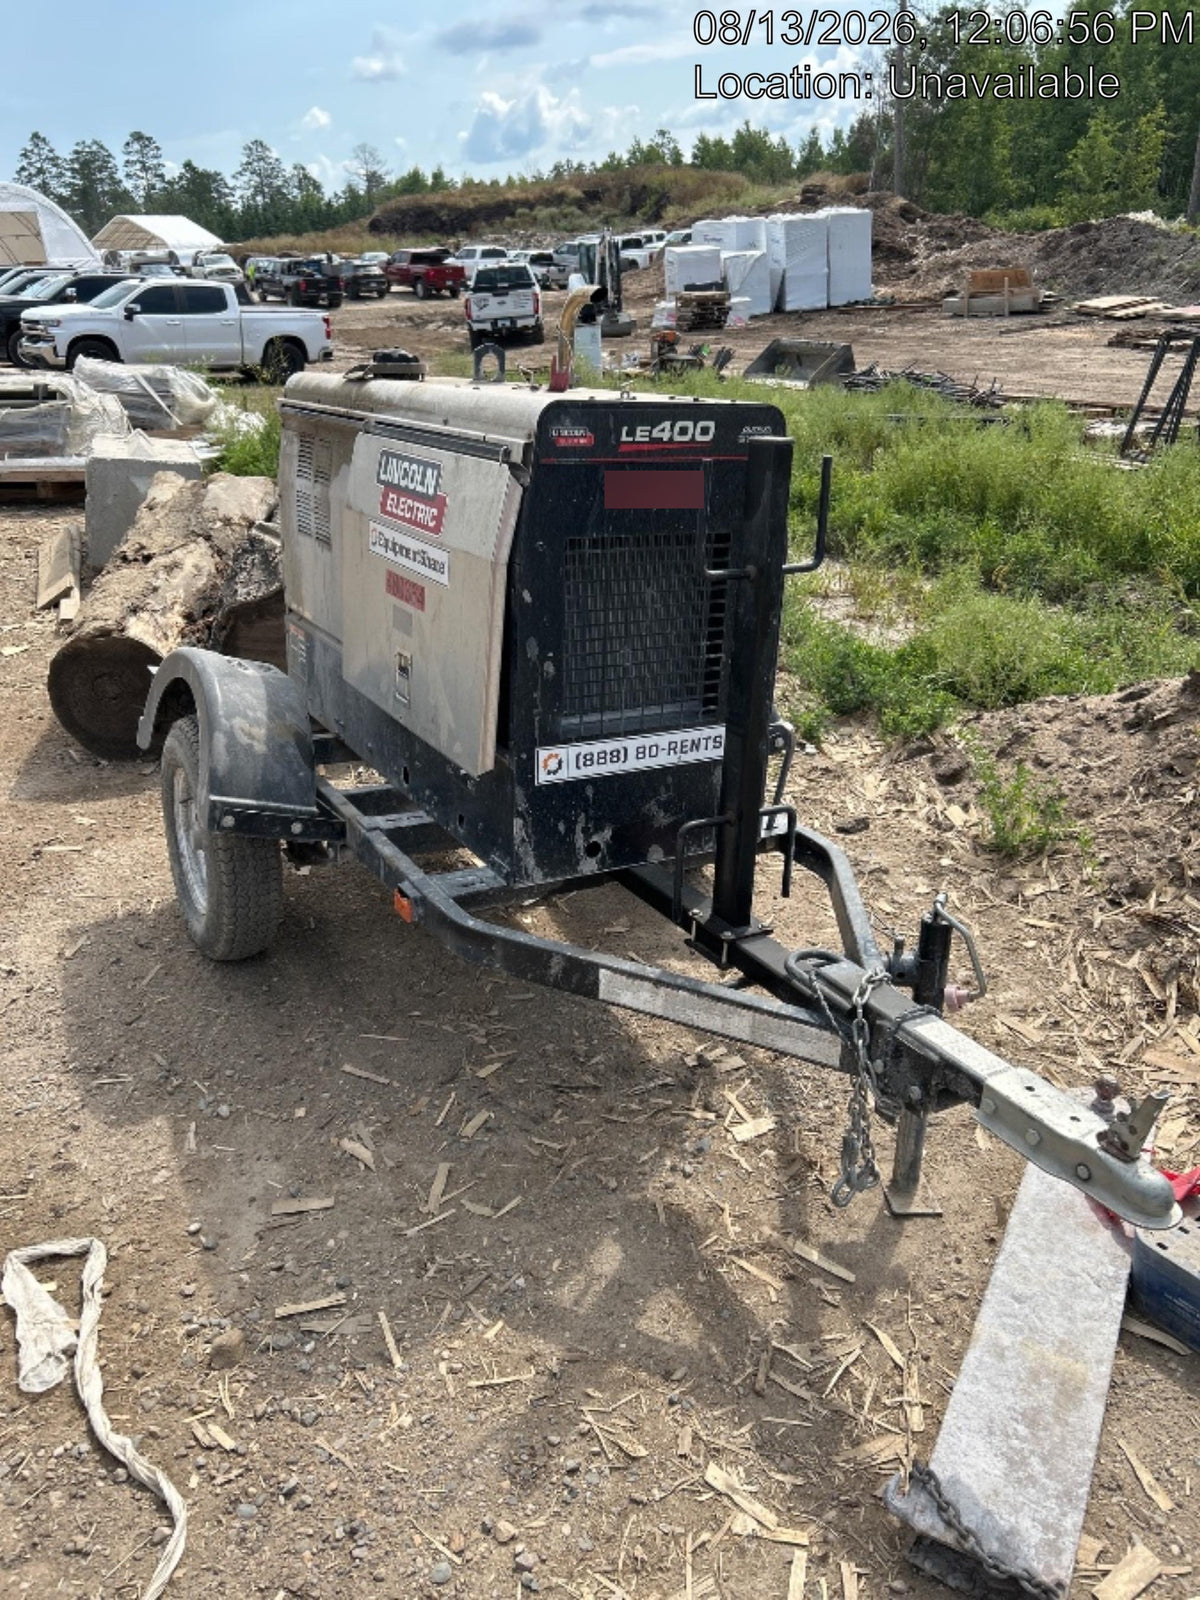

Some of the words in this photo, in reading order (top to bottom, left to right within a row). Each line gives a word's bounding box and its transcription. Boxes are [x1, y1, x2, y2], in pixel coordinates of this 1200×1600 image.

[620, 420, 716, 442] LE400
[379, 455, 438, 496] LINCOLN
[386, 491, 438, 528] ELECTRIC
[575, 746, 628, 770] (888)
